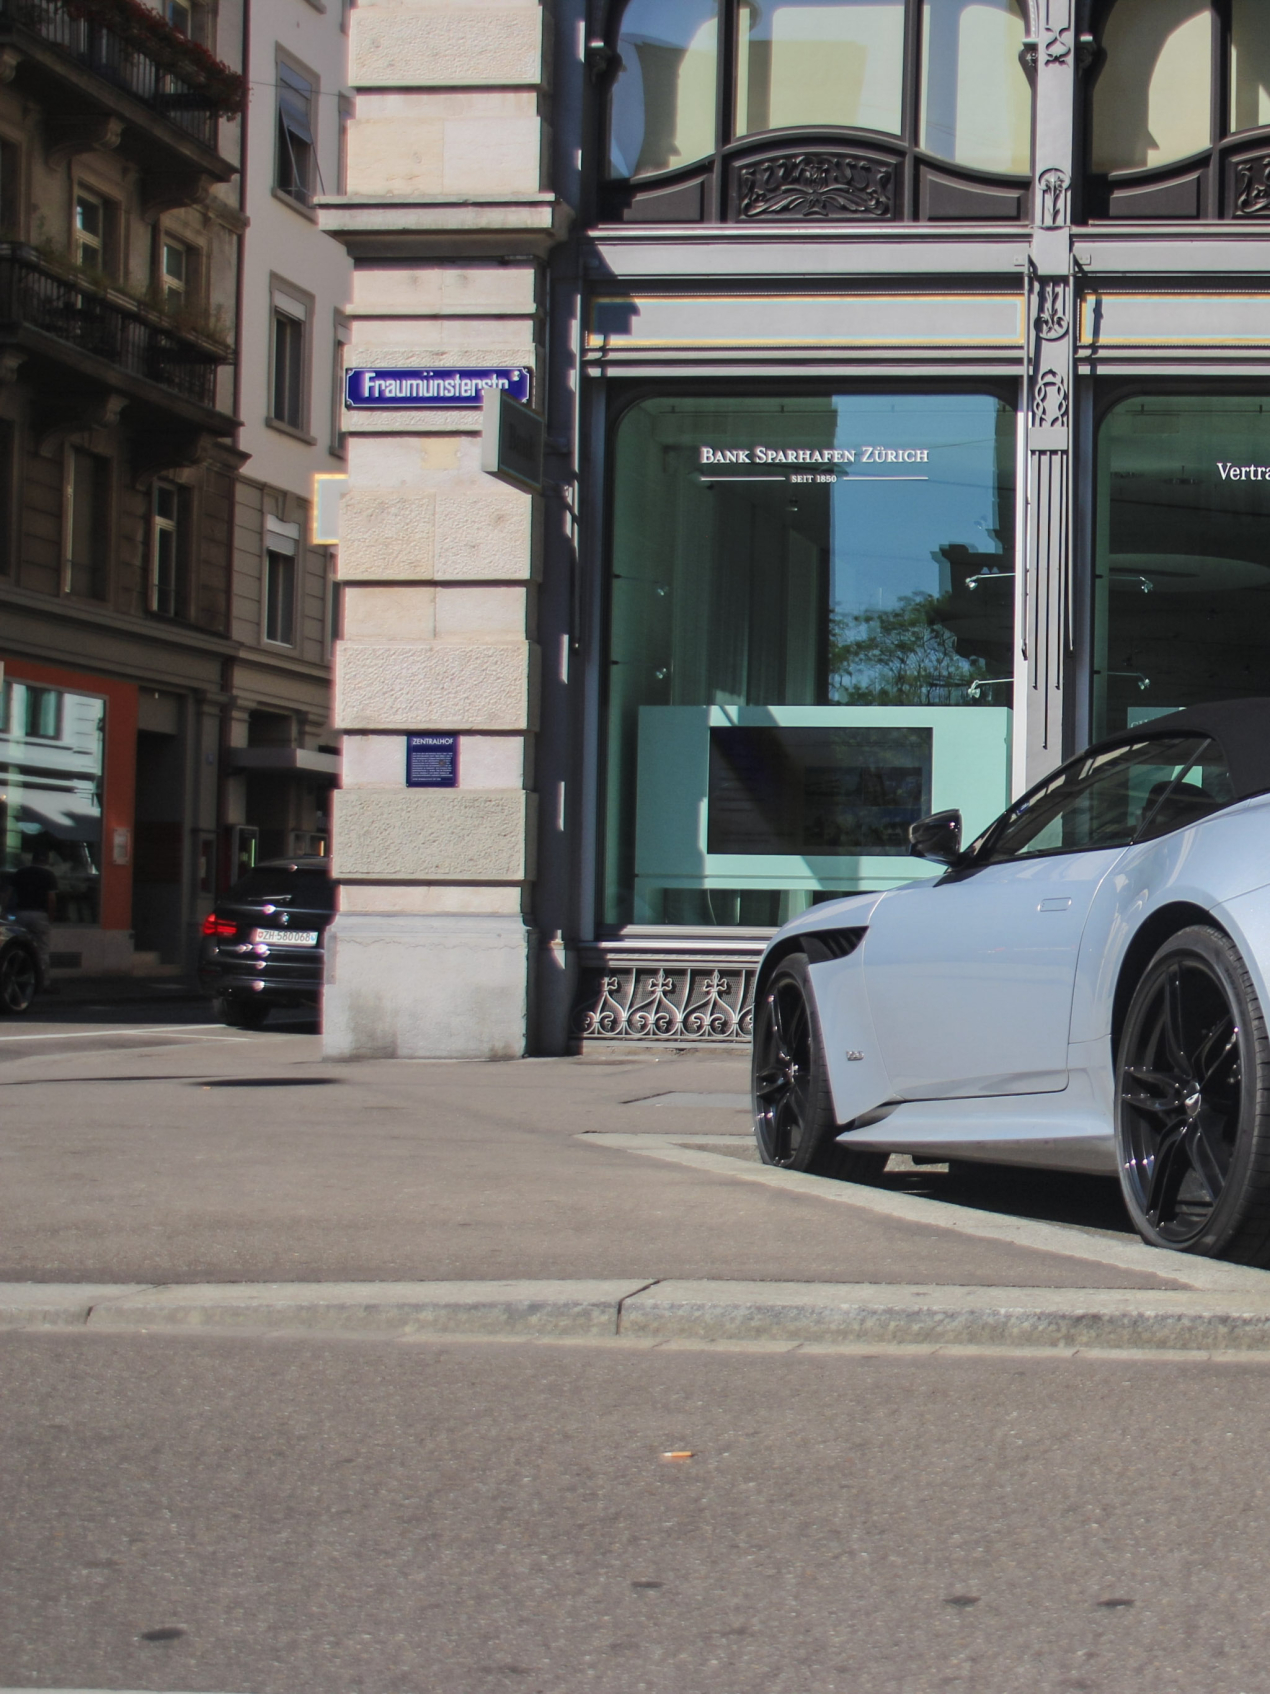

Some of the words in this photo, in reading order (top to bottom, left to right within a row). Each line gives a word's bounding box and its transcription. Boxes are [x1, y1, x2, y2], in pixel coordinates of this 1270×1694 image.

[700, 446, 751, 463] BANK
[755, 445, 856, 464] SPARHAFEN
[862, 445, 930, 463] ZÜRICH
[790, 474, 814, 484] SEIT
[816, 474, 837, 484] 1850
[412, 737, 454, 745] ZENTRALHOF
